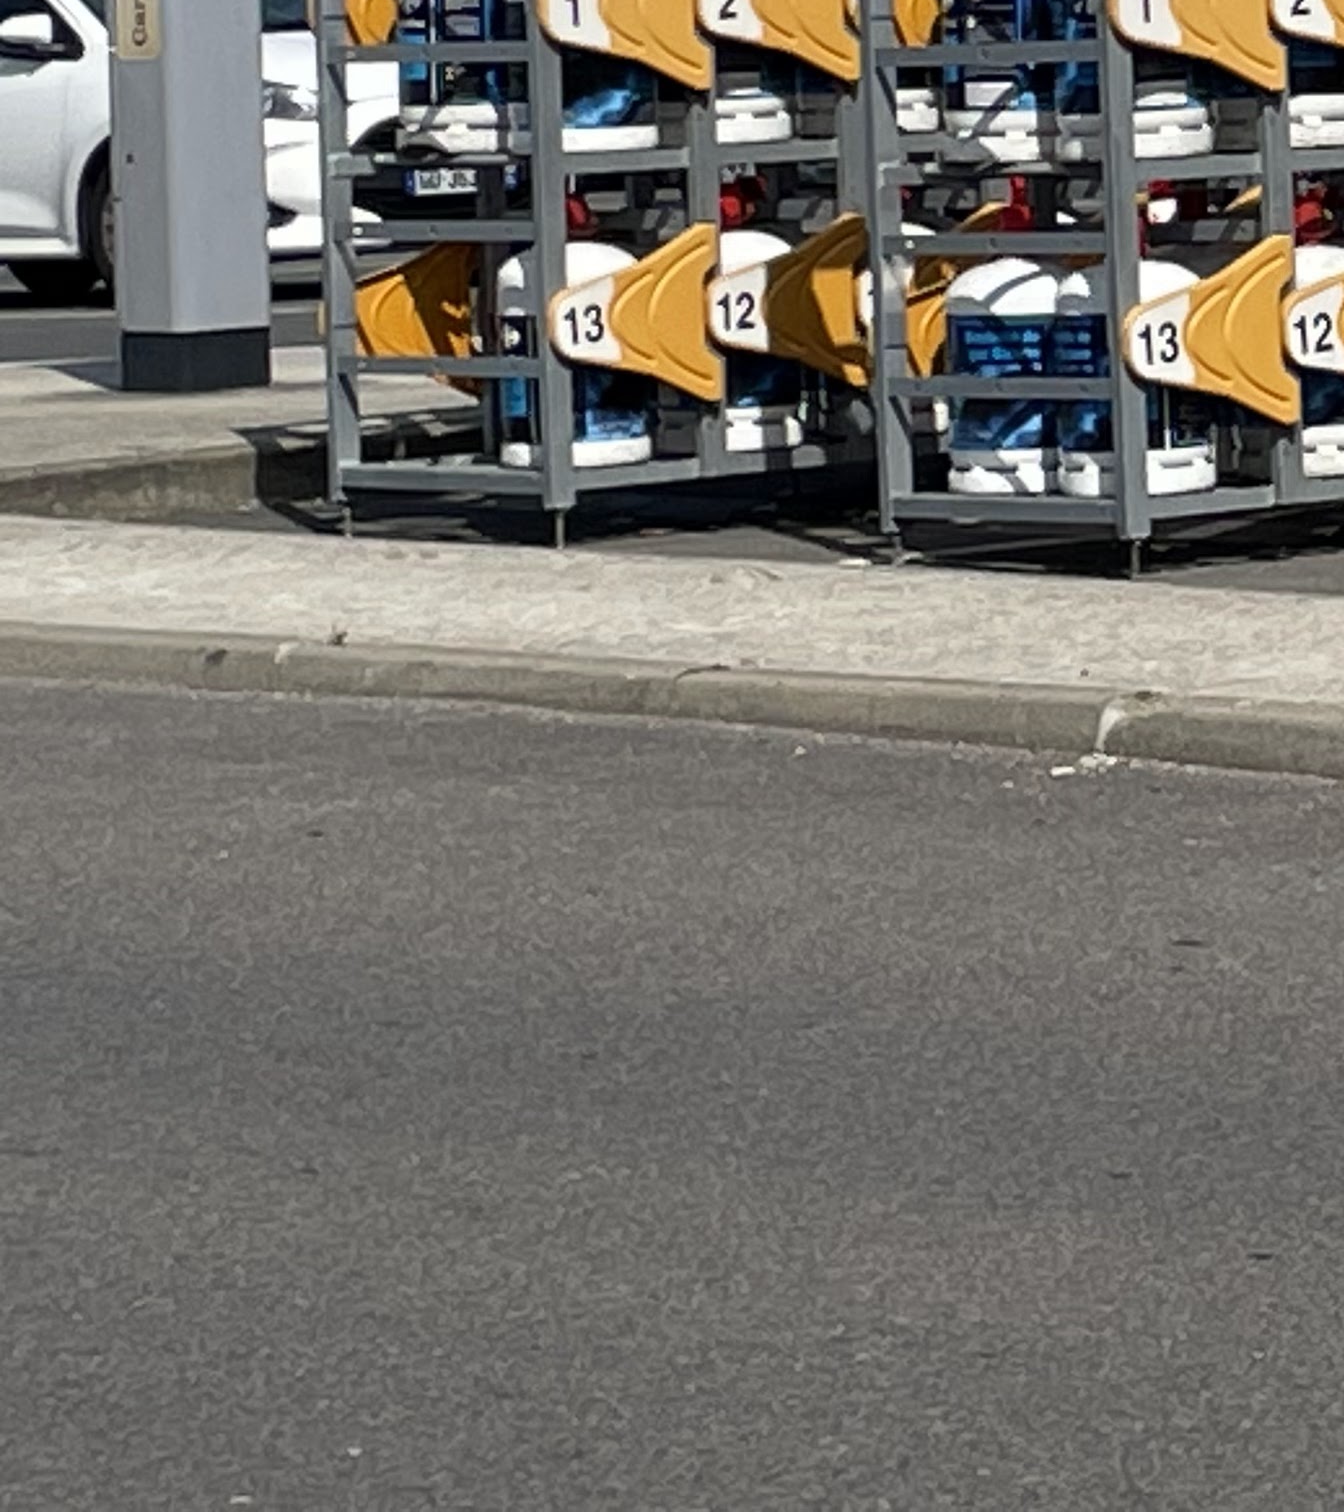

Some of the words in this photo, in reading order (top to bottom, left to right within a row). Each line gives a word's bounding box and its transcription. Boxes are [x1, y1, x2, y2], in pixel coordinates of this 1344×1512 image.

[563, 304, 605, 345] 13
[716, 292, 756, 331] 12
[1137, 322, 1180, 366] 13
[1293, 313, 1334, 355] 12
